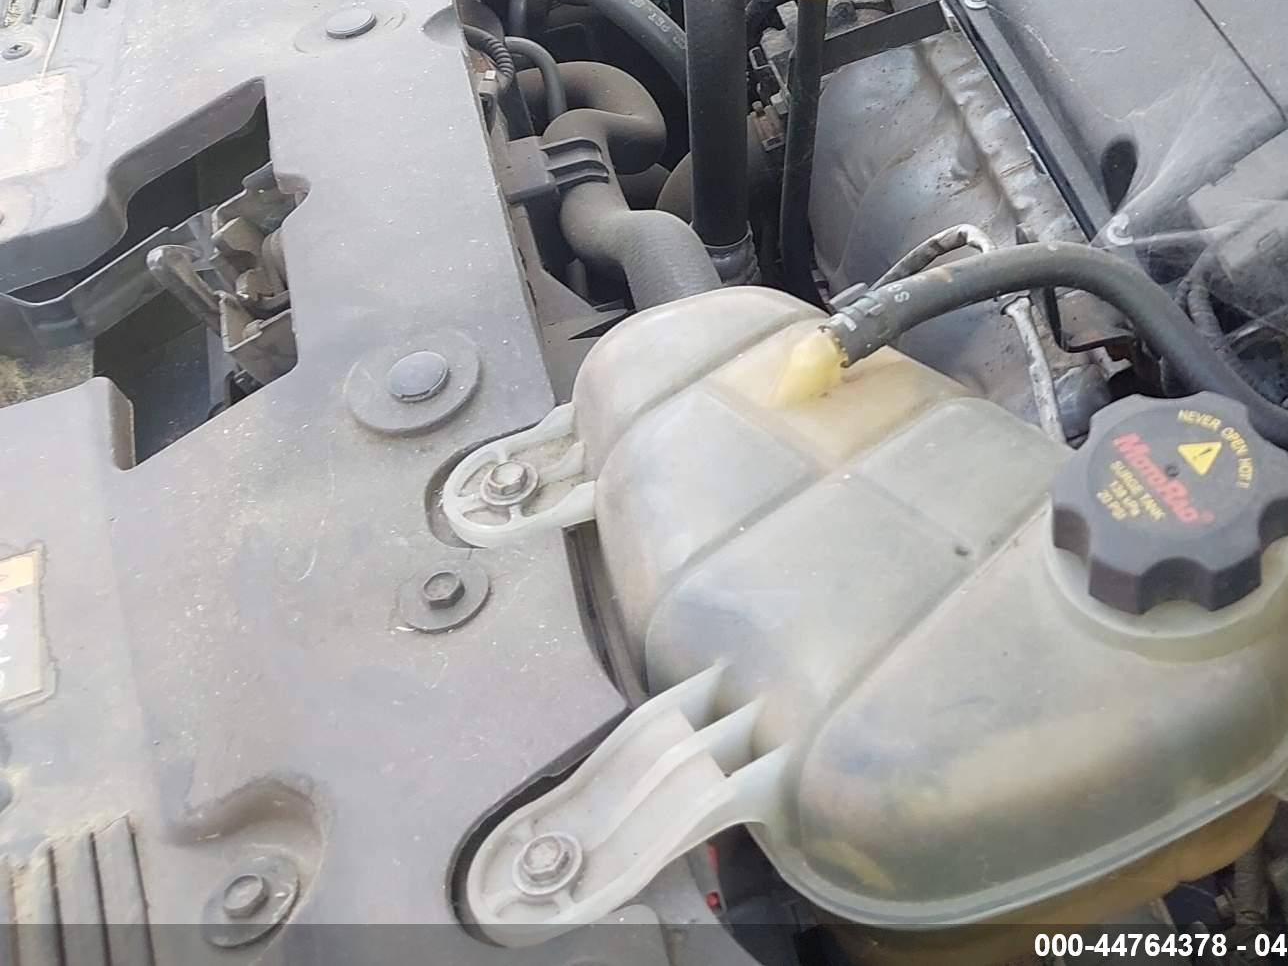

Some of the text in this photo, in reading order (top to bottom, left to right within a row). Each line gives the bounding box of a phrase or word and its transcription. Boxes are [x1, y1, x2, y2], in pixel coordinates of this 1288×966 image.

[1177, 409, 1222, 432] NEVER
[1220, 426, 1249, 457] OPEN
[1109, 460, 1167, 522] SURGE TANK
